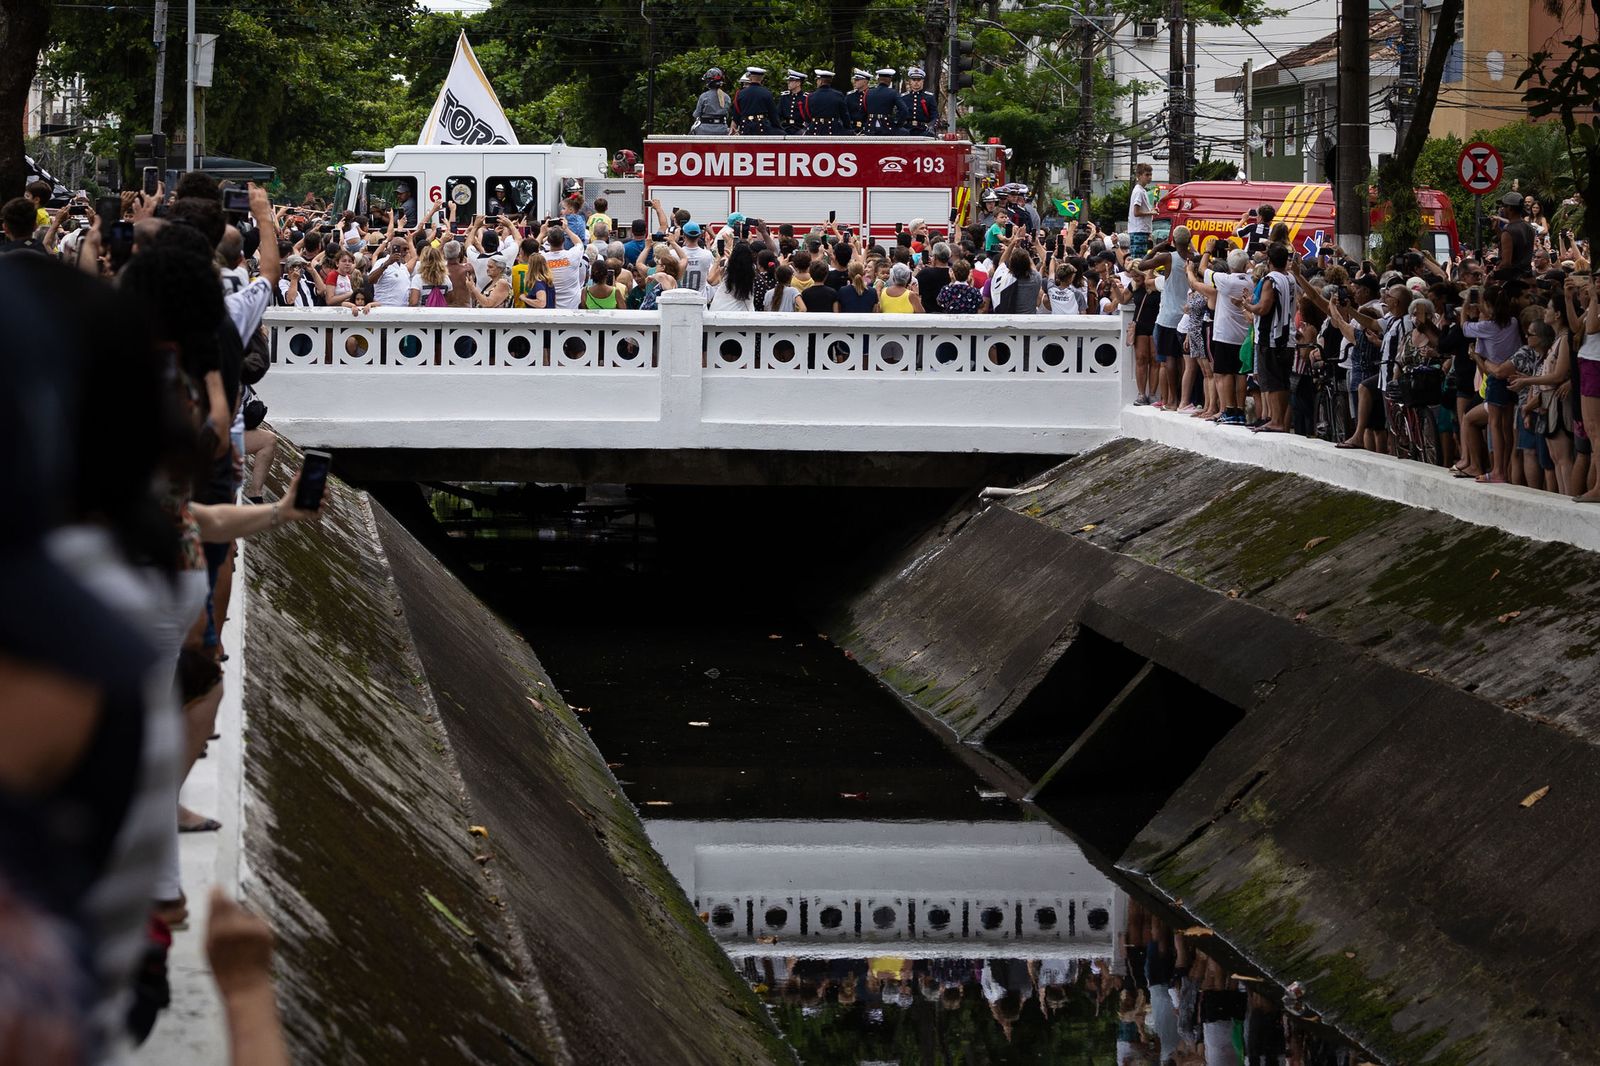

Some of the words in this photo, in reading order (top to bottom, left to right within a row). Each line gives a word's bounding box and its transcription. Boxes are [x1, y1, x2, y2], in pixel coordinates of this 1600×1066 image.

[439, 88, 511, 145] TOR
[657, 152, 858, 177] BOMBEIROS
[913, 156, 945, 173] 193
[429, 185, 442, 203] 6
